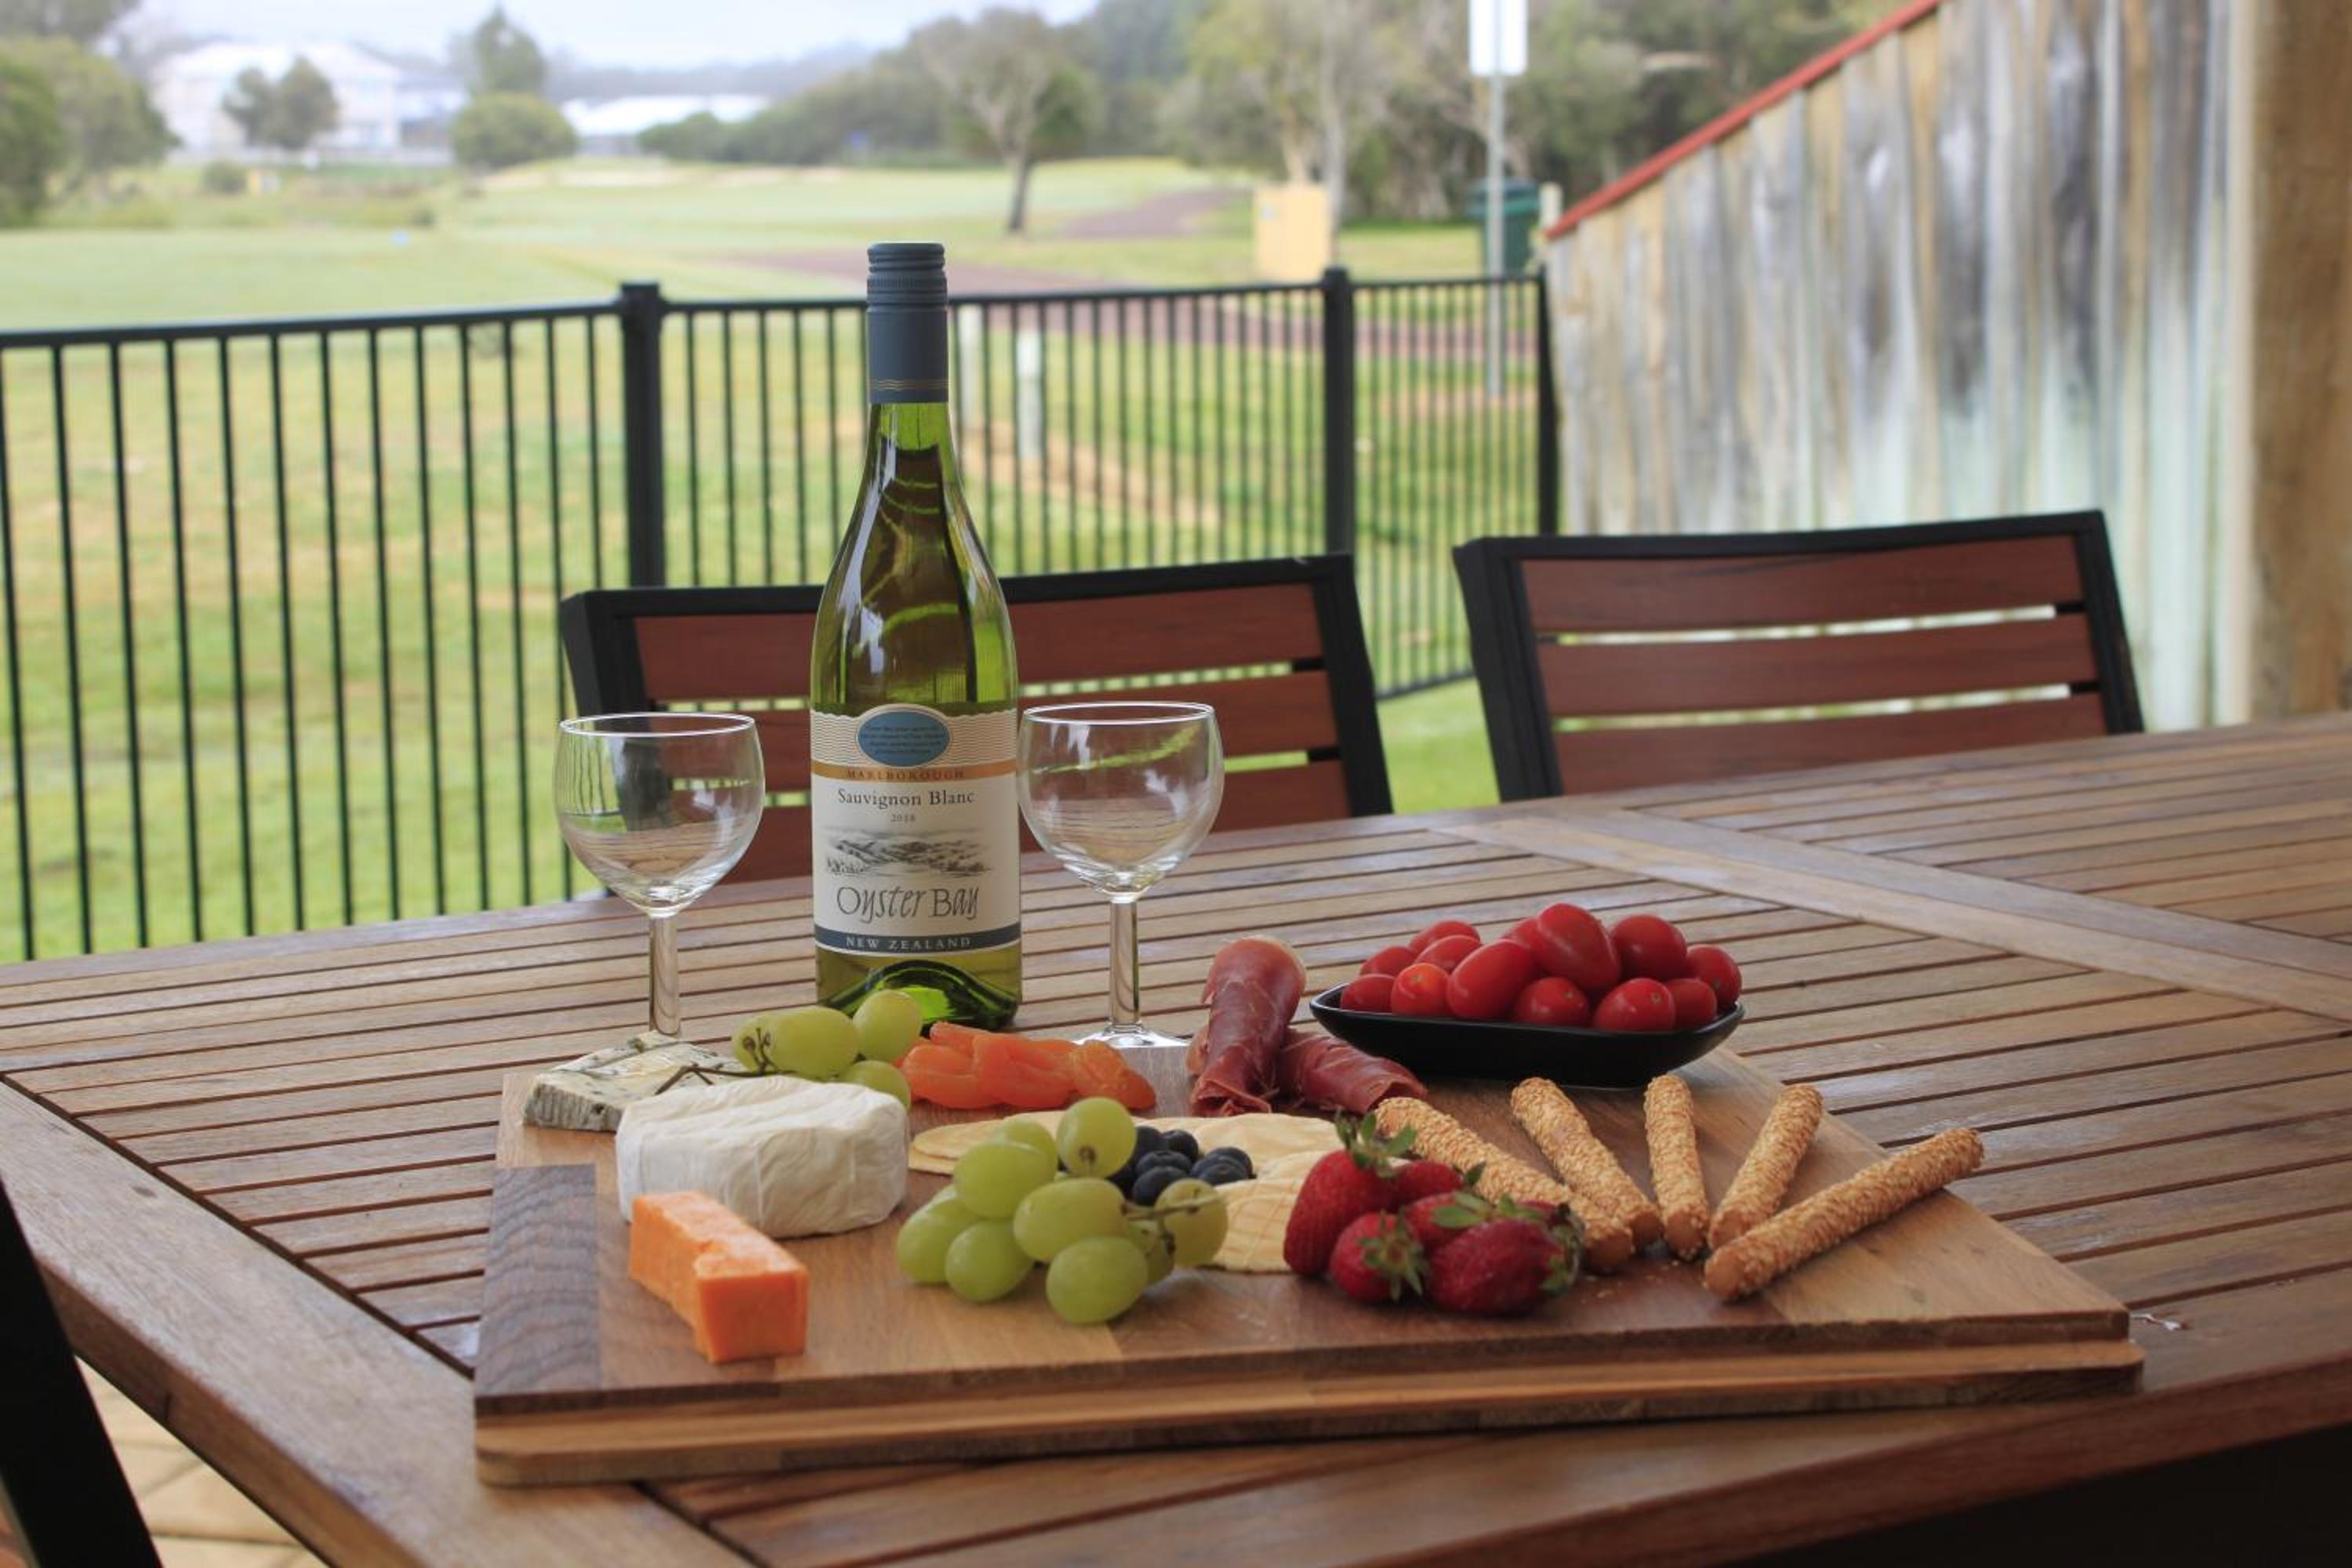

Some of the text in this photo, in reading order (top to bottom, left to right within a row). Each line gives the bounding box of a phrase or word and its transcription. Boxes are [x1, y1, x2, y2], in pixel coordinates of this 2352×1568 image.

[847, 770, 964, 780] MARLBOROUGH
[838, 788, 975, 809] Sauvignon Blanc
[837, 886, 978, 924] Oyster Bay
[846, 936, 970, 951] NEW ZEALAND
